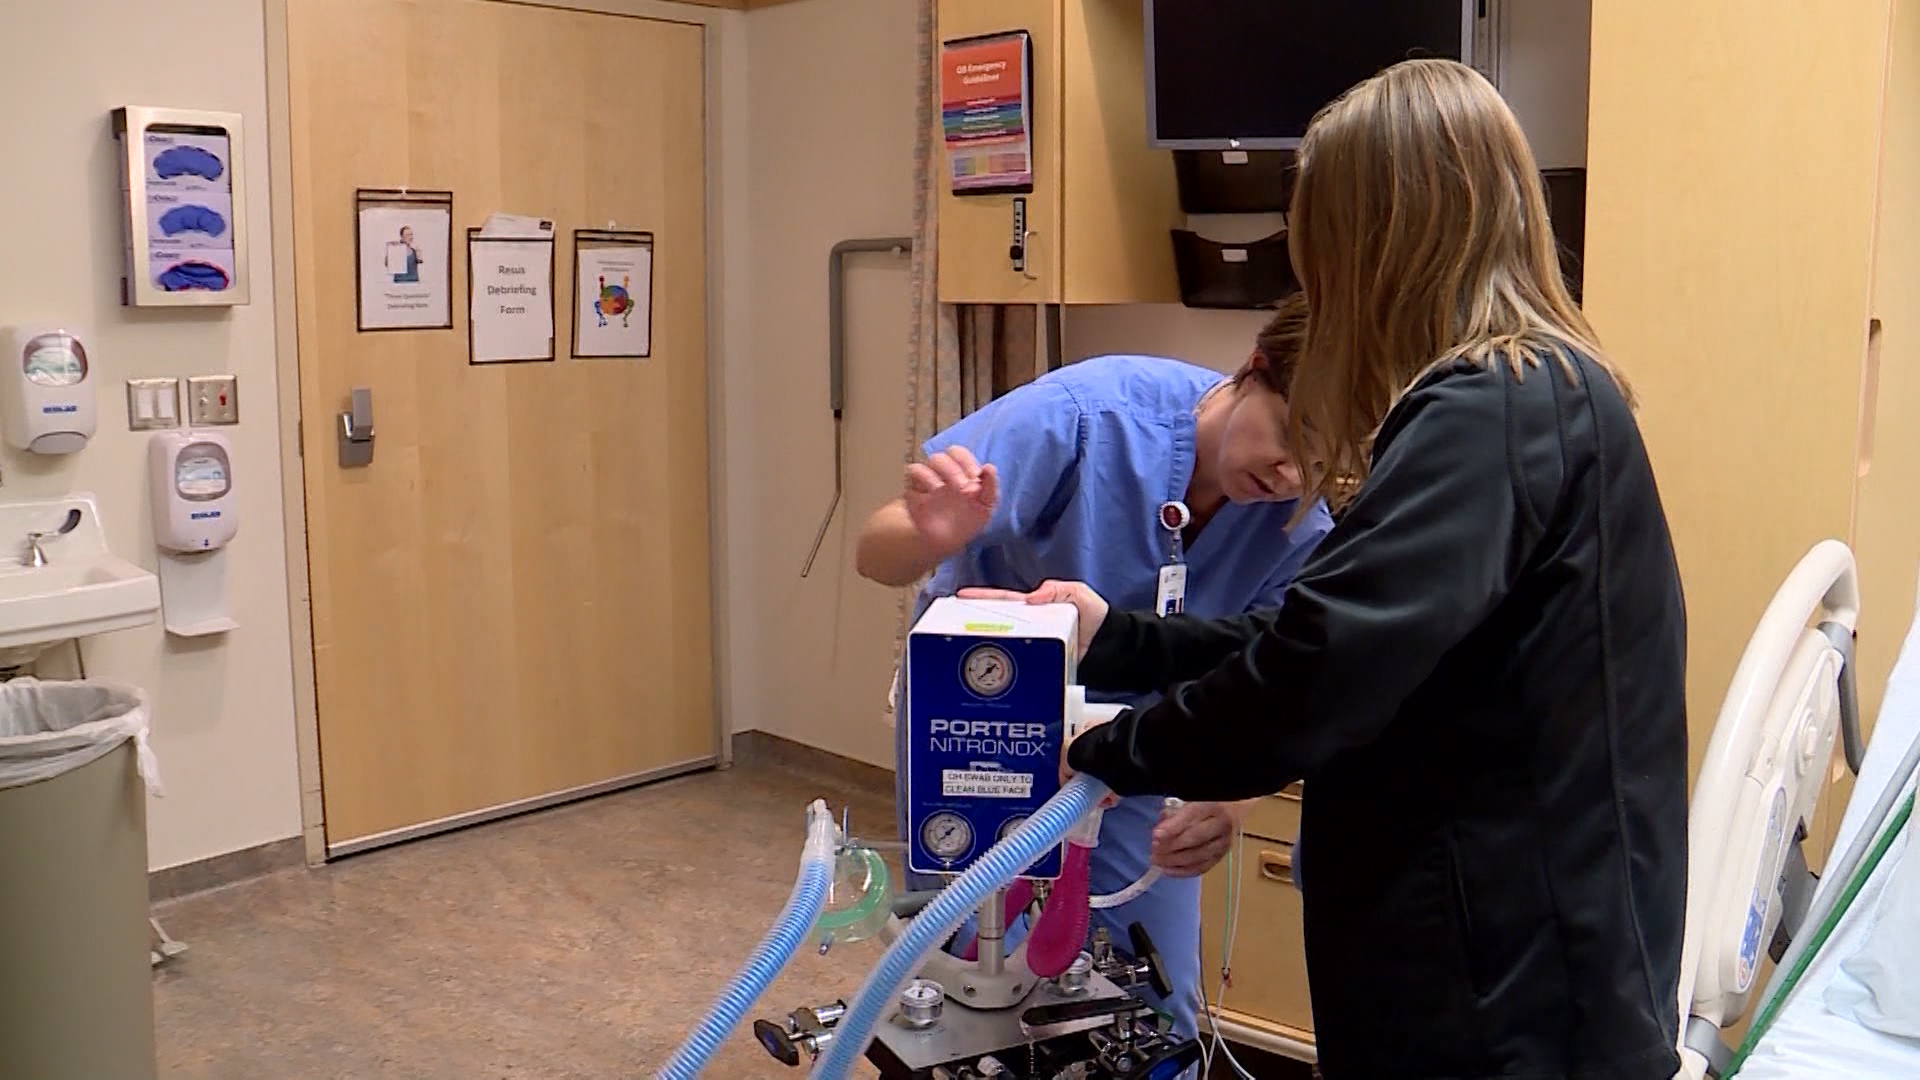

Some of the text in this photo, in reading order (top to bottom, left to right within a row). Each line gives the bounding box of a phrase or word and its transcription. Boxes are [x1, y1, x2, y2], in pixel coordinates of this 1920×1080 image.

[968, 61, 1007, 72] Emergency
[963, 73, 1000, 85] Guidelines
[498, 265, 526, 274] Resus
[487, 284, 538, 296] Debriefing
[500, 305, 526, 314] Form
[930, 719, 1046, 738] PORTER
[993, 775, 1016, 784] ONLY
[1019, 775, 1032, 784] TO
[944, 785, 975, 794] CLEAN
[977, 786, 1000, 794] BLUE
